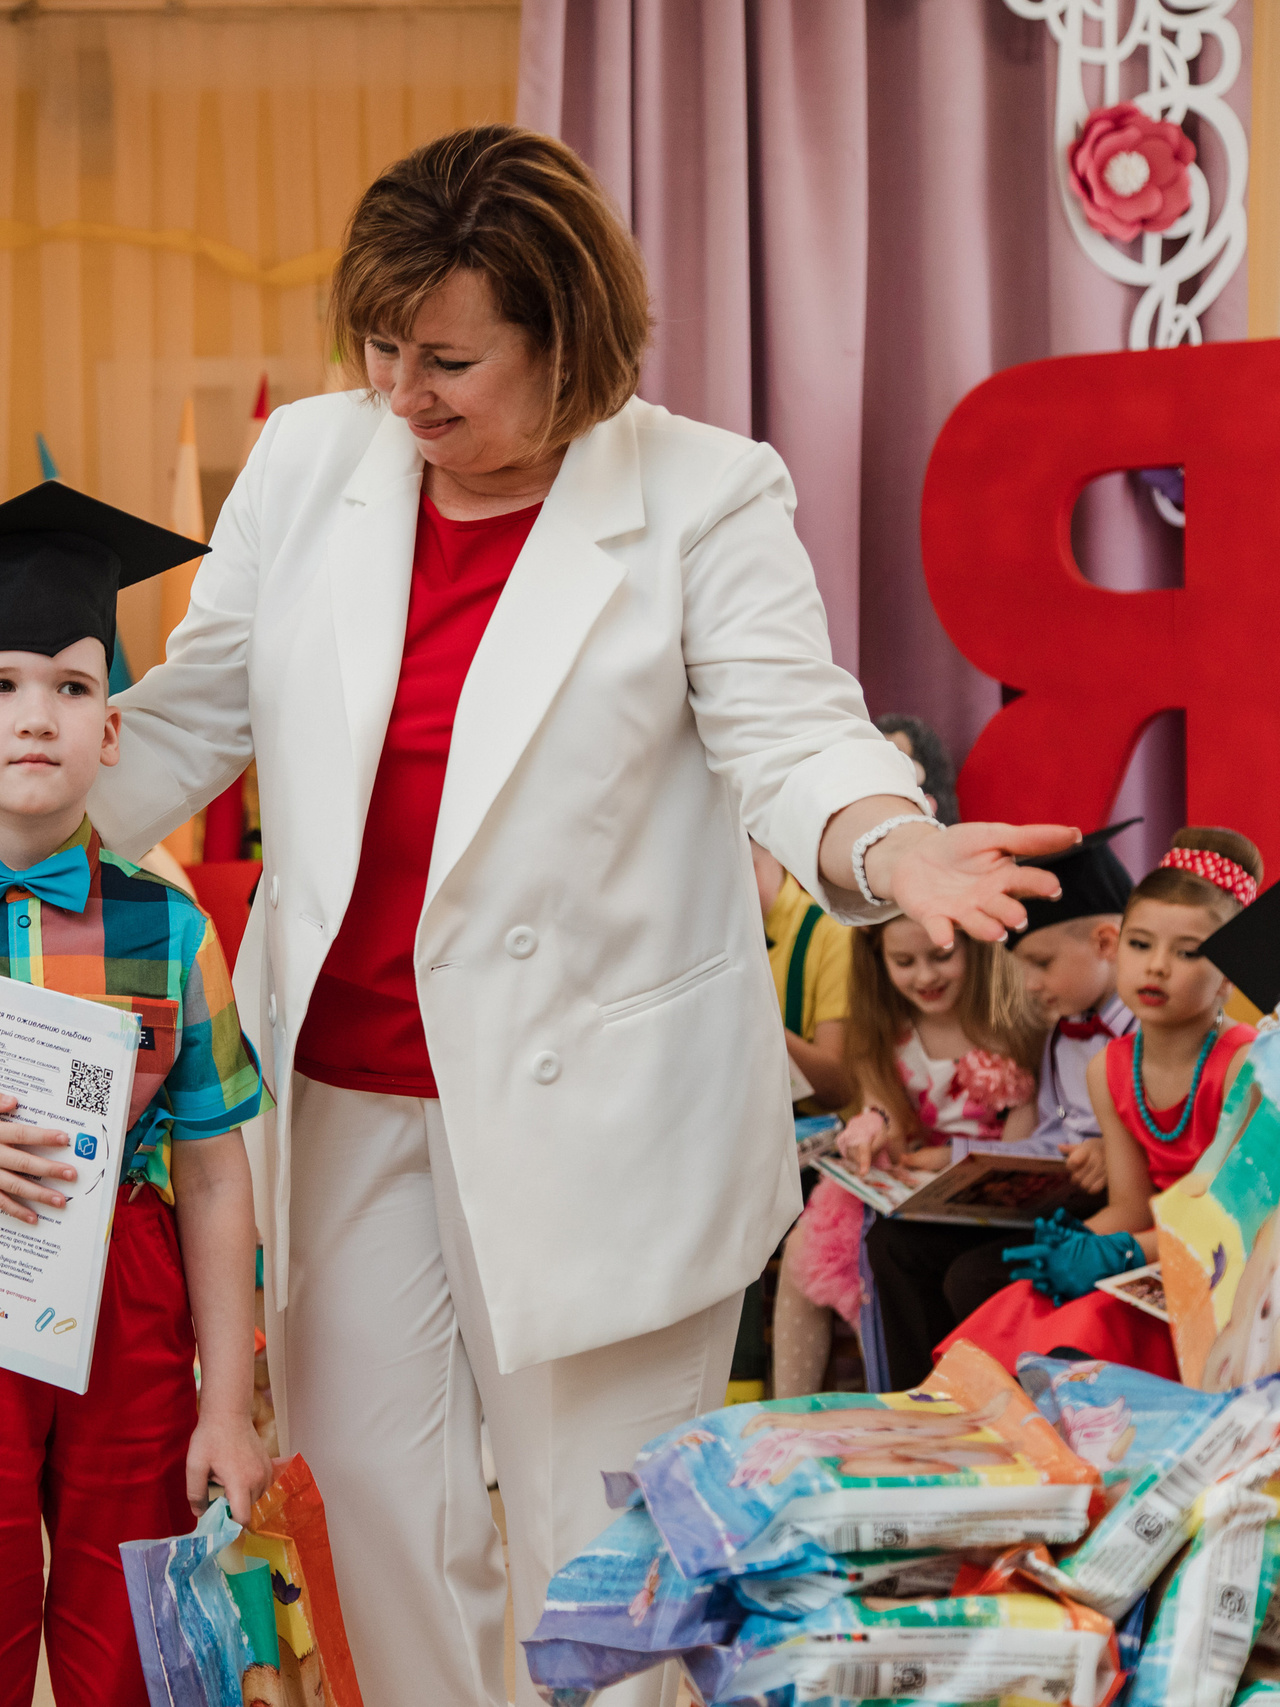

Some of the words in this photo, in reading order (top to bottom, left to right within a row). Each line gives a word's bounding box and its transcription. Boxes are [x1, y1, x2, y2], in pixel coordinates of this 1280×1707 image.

[16, 1017, 60, 1033] оживлению
[60, 1029, 92, 1043] альбома
[14, 1033, 35, 1043] способ
[36, 1040, 72, 1053] оживления:
[28, 1107, 46, 1115] через
